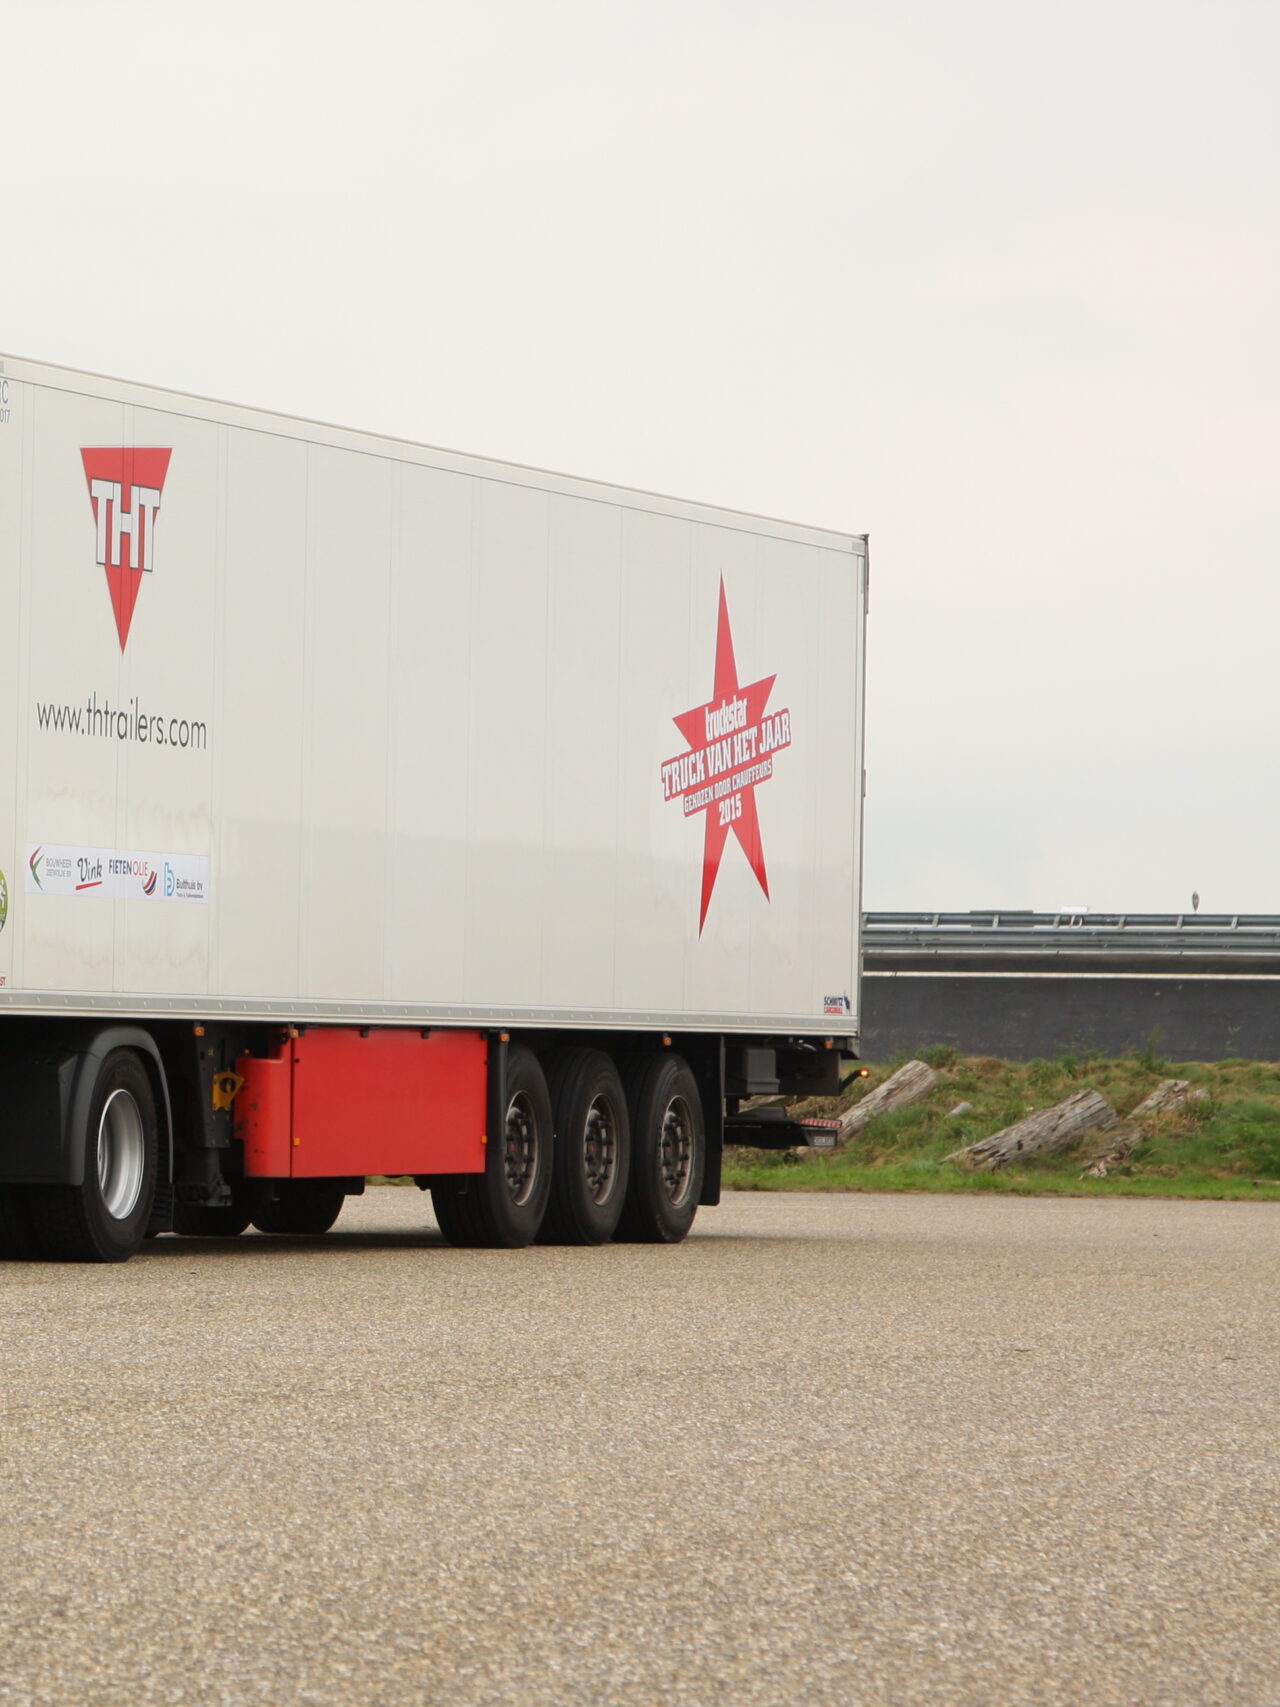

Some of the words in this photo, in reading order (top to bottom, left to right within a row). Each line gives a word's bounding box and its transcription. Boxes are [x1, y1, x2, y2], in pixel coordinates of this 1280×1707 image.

[91, 477, 161, 573] THT
[36, 690, 208, 750] www.thtrailers.com
[704, 694, 748, 743] truckstar
[662, 748, 706, 799] TRUCK
[705, 737, 732, 779] VAN
[733, 725, 759, 767] HET
[760, 711, 791, 755] JAAR
[684, 784, 715, 814] GEKOZEN
[718, 792, 743, 827] 2015
[77, 857, 103, 882] Vink
